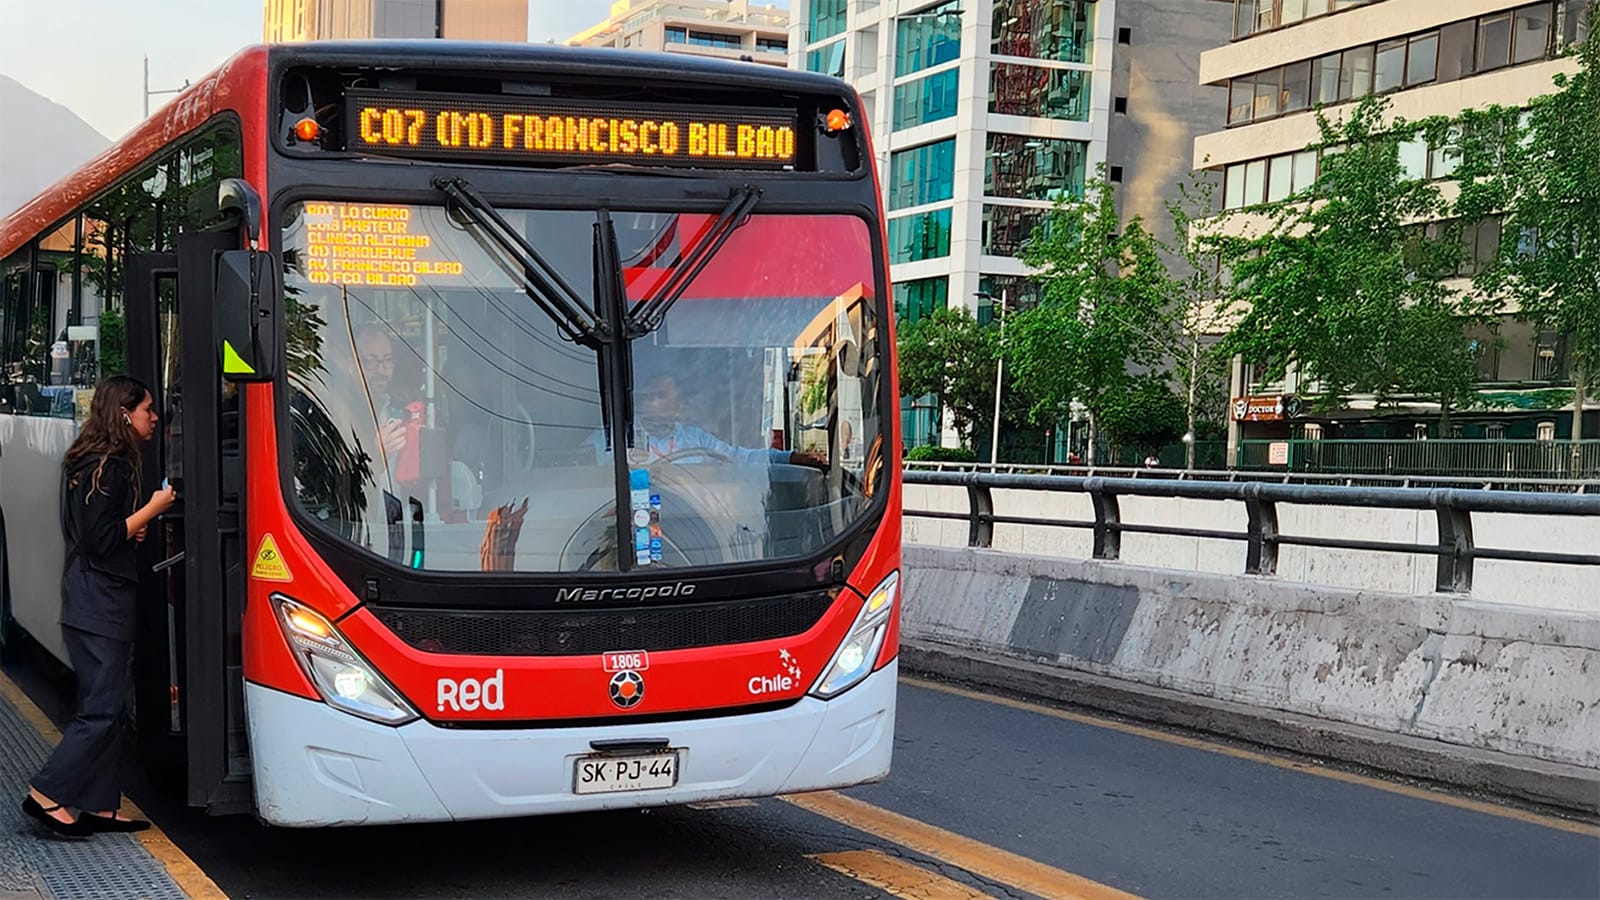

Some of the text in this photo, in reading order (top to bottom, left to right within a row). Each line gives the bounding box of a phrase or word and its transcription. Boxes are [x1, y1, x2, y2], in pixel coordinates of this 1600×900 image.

[360, 107, 794, 159] C07 (M) FRANCISCO BILBAO
[340, 206, 360, 219] LO
[362, 207, 409, 221] CURRO
[343, 219, 407, 234] PASTEUR
[307, 232, 430, 248] CLINICA ALEMANA
[307, 245, 416, 260] (M) MANQUEHUE
[307, 258, 462, 274] AV. FRANCISCO BILBAO
[307, 271, 416, 286] (M) FCO. BILBAO
[1248, 405, 1274, 414] DOCTOR
[555, 582, 696, 602] Marcopolo
[611, 655, 641, 669] 1806
[437, 668, 504, 712] Red
[748, 674, 792, 694] Chile
